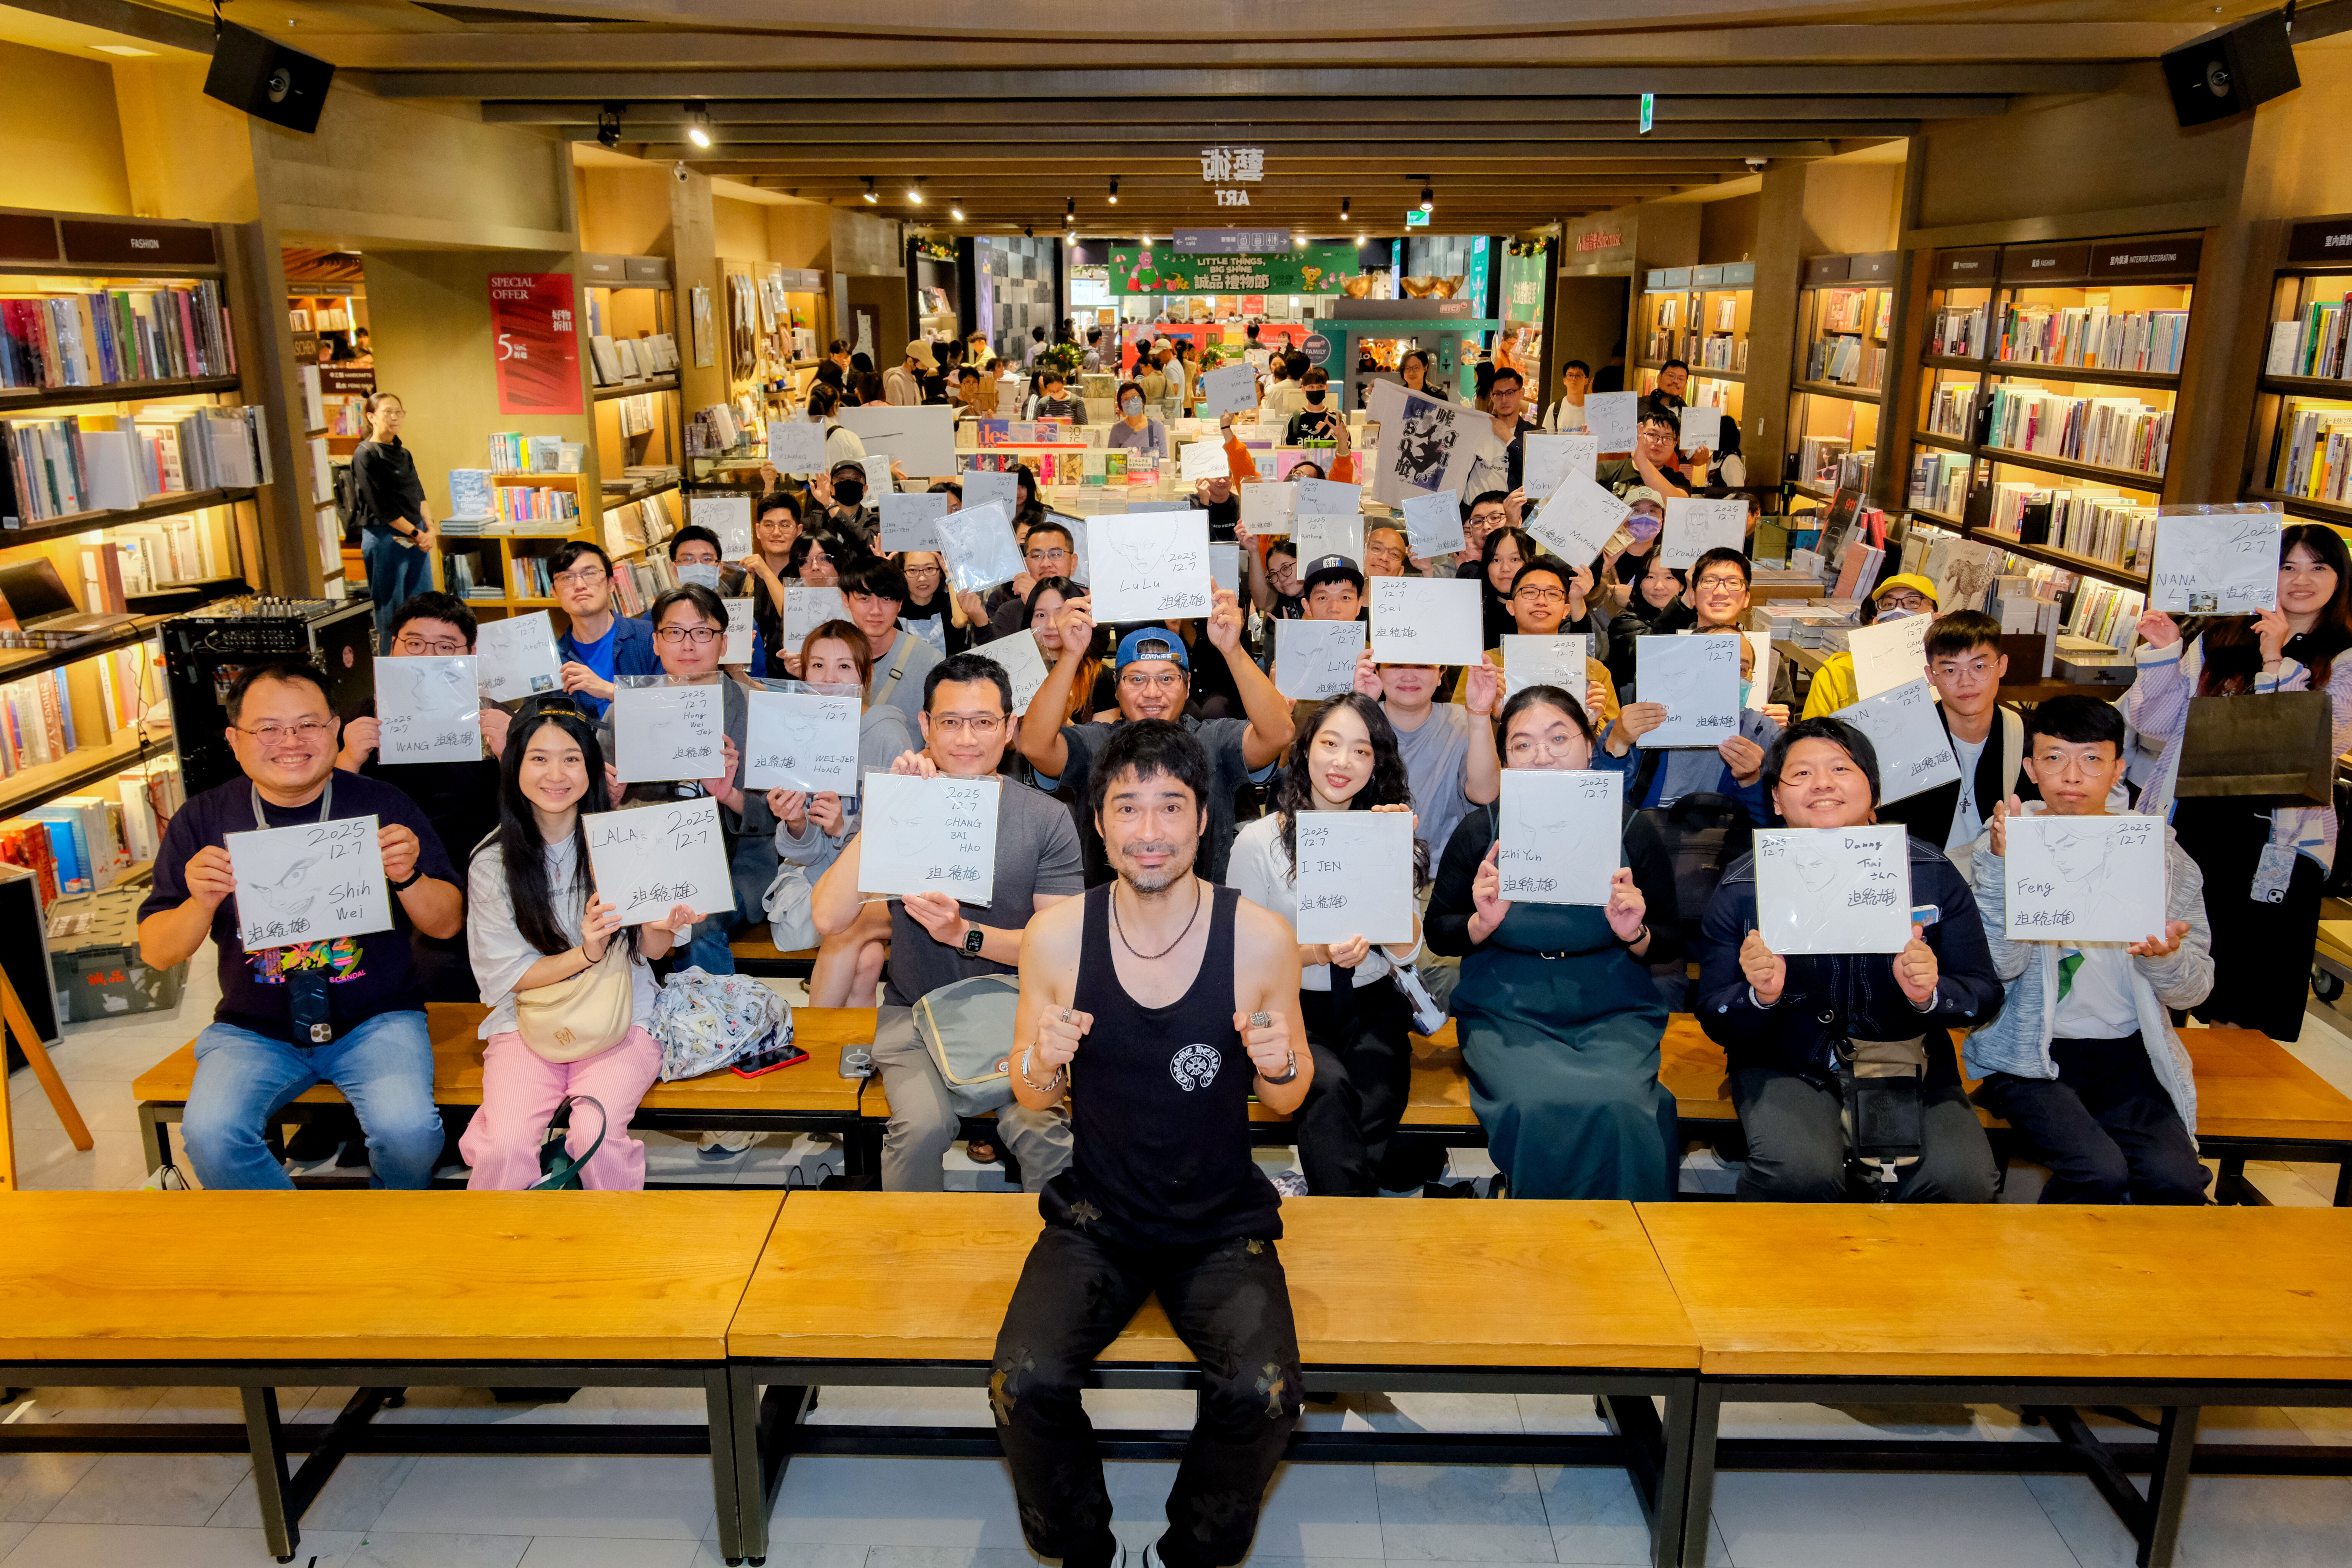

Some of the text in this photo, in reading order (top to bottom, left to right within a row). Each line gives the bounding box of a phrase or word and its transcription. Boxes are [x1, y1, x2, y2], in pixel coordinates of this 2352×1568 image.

[131, 238, 159, 248] FASHION
[1198, 257, 1228, 266] LITTLE
[2149, 253, 2176, 263] DECORATING
[1226, 265, 1252, 273] SHINE
[491, 277, 535, 287] SPECIAL
[492, 289, 529, 299] OFFER
[498, 333, 513, 360] 5
[1233, 366, 1248, 374] 2025
[1592, 395, 1627, 409] 2025
[1183, 445, 1205, 455] 2025
[1561, 439, 1595, 455] 2025
[867, 456, 888, 469] 2025
[1428, 494, 1455, 509] 2025
[1602, 496, 1627, 513] 2025
[1845, 498, 1857, 511] 911
[692, 502, 714, 519] 2025
[945, 518, 962, 529] 2025
[2229, 520, 2277, 543] 2025
[1168, 552, 1197, 563] 2025
[2156, 573, 2196, 586] NANA
[1379, 604, 1401, 613] Sei
[515, 617, 538, 629] 2025
[1904, 619, 1924, 629] 2025
[1330, 624, 1362, 635] 2025
[1705, 640, 1735, 651] 2025
[680, 690, 706, 700] 2025
[1896, 685, 1921, 700] 2025
[40, 682, 53, 723] Shoes
[384, 716, 412, 725] 2025
[396, 741, 429, 751] WANG
[815, 754, 855, 764] WEI-JER
[1579, 778, 1609, 788] 2025
[946, 786, 980, 799] 2025
[667, 809, 714, 834] 2025
[945, 817, 982, 828] CHANG
[307, 822, 365, 846] 2025
[1300, 828, 1329, 839] 2025
[2116, 823, 2152, 834] 2025
[593, 827, 637, 848] LALA
[950, 831, 967, 840] BAI
[960, 843, 980, 853] HAO
[1761, 838, 1787, 849] 2025
[1845, 838, 1883, 850] Danny
[1302, 860, 1341, 873] I JEN
[1870, 872, 1897, 881] さんへ
[2017, 878, 2055, 897] Feng
[336, 907, 363, 920] Wei
[329, 969, 366, 983] SCANDAL
